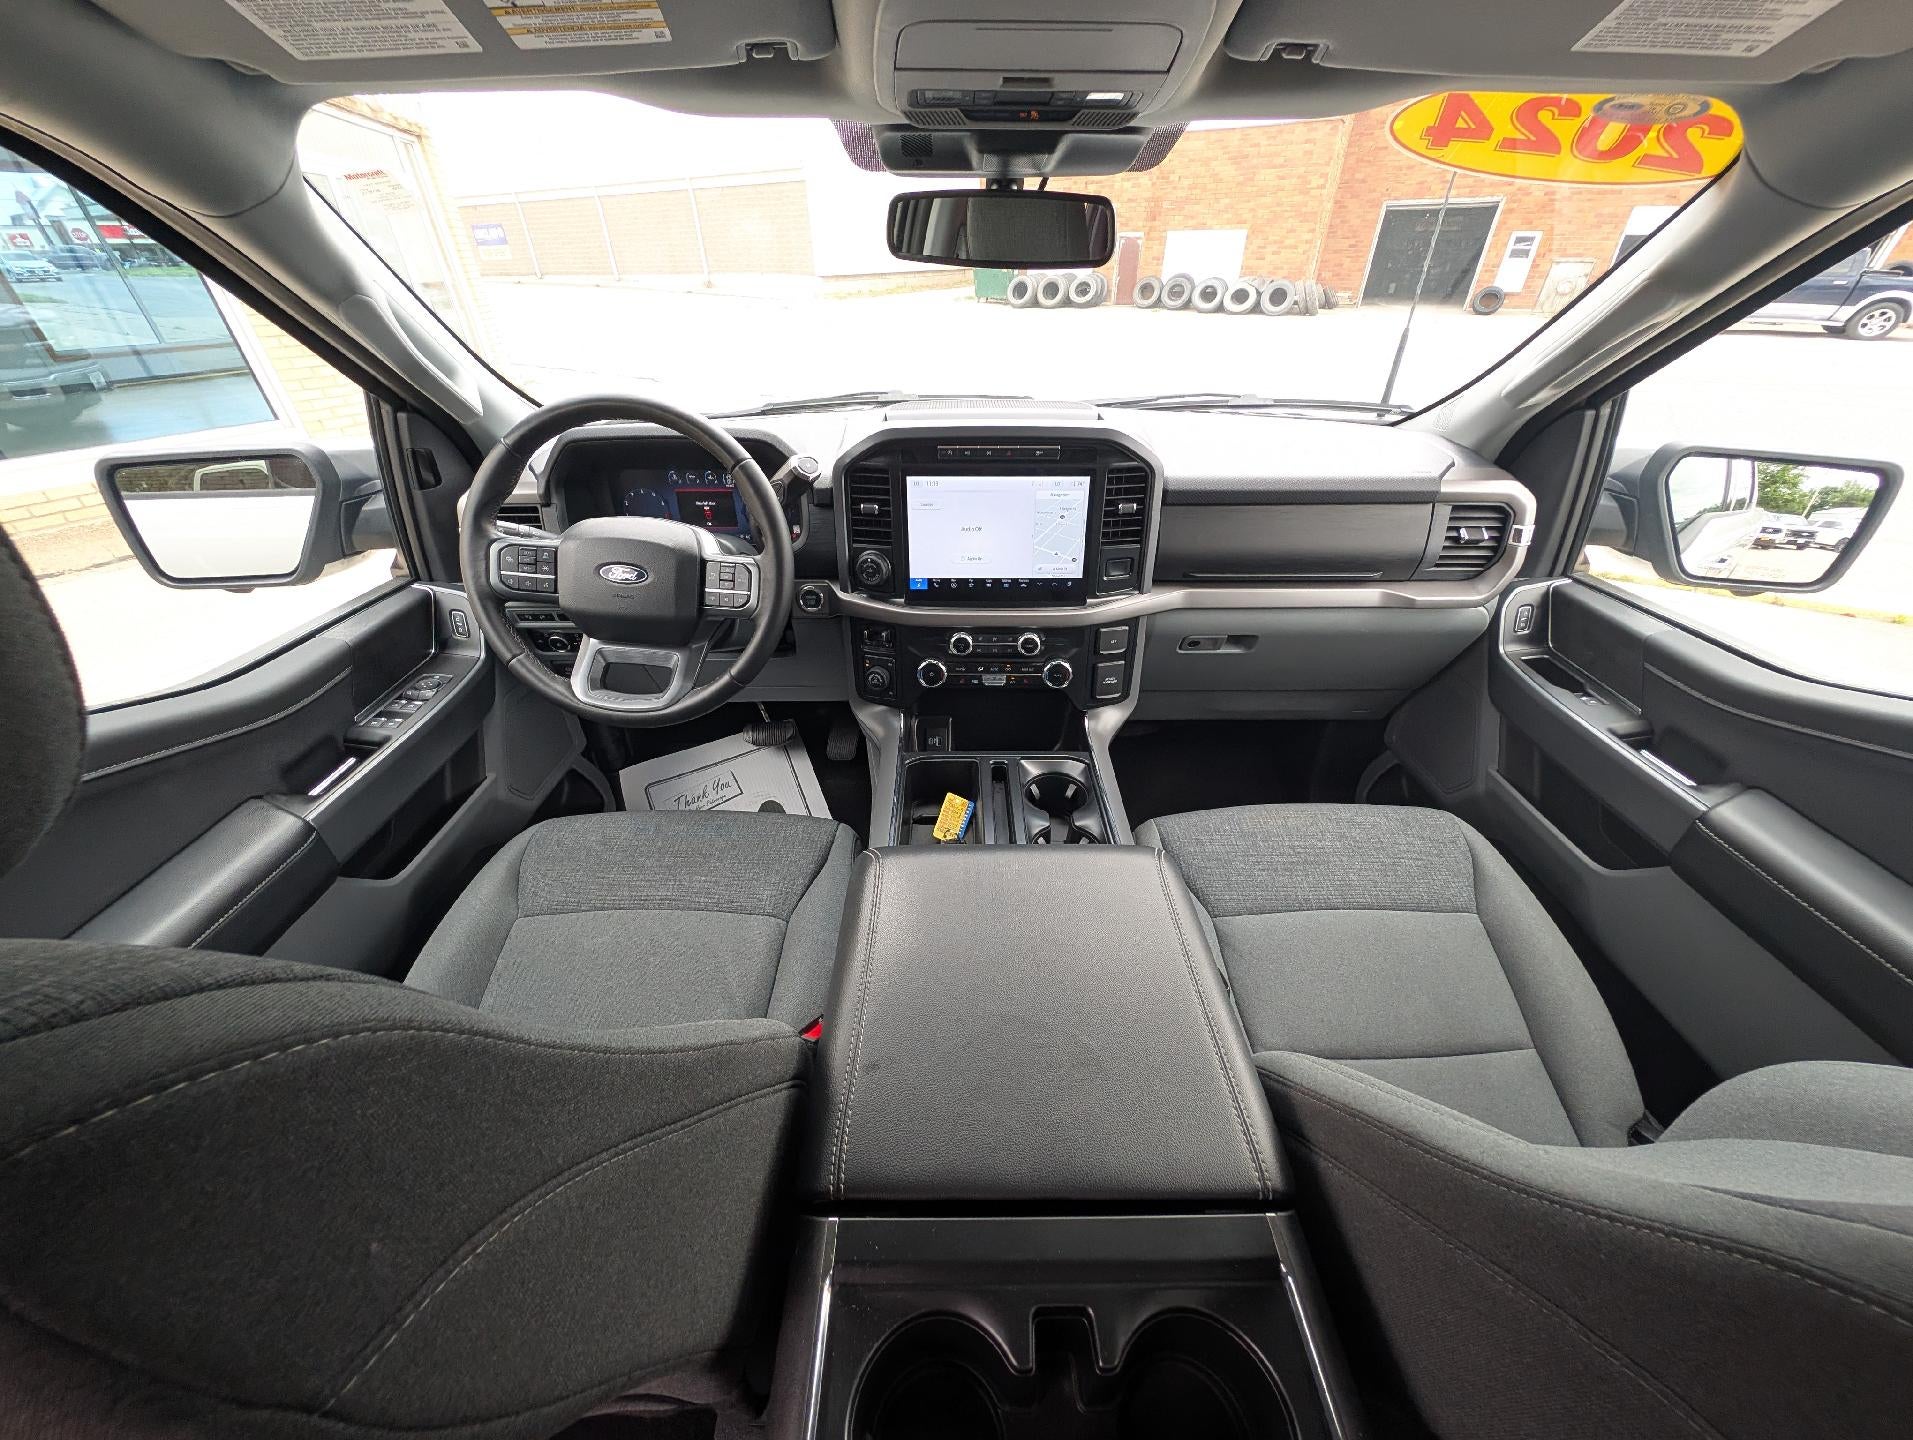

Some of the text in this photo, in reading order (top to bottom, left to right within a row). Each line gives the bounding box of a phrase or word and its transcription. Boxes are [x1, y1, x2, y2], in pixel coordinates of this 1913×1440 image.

[608, 566, 639, 581] Ford
[674, 777, 732, 810] Thank You
